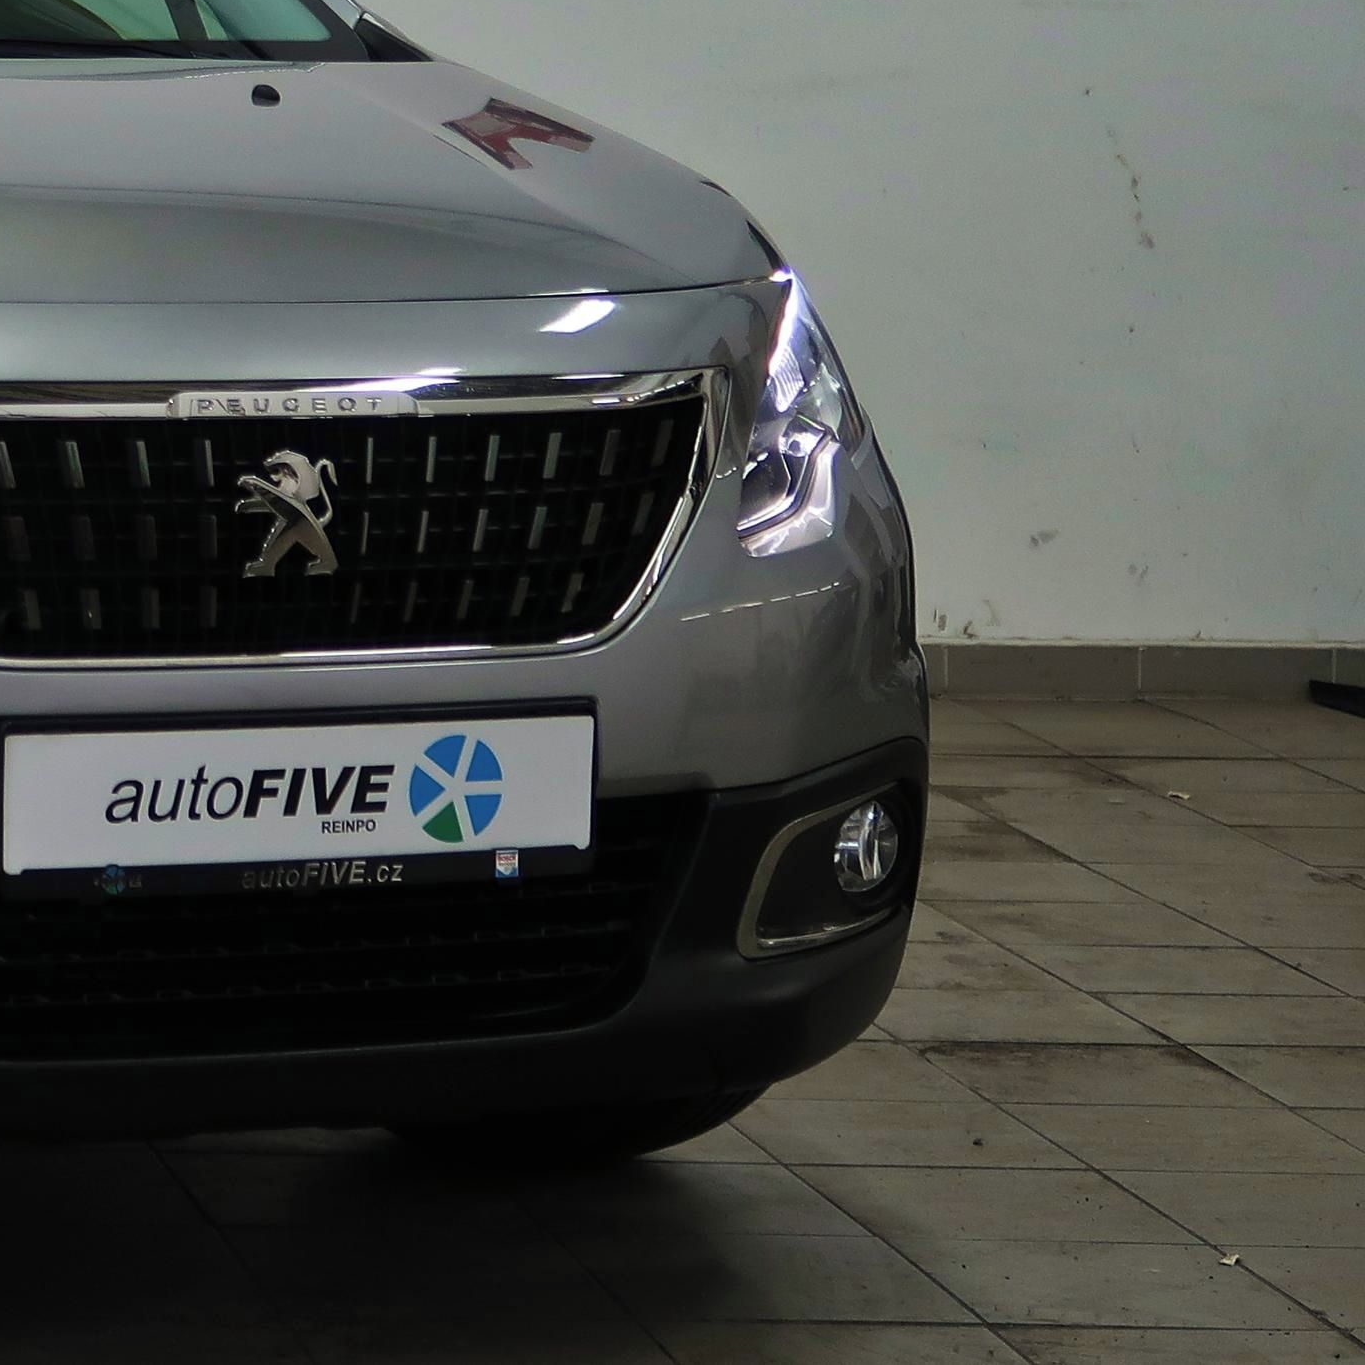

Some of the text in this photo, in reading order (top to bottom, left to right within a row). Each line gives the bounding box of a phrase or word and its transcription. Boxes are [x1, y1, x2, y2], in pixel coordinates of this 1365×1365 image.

[197, 397, 382, 414] PEUGEOT
[104, 764, 395, 825] autoFIVE
[321, 819, 376, 834] REINPO
[241, 860, 404, 890] autoFIVE.cz
